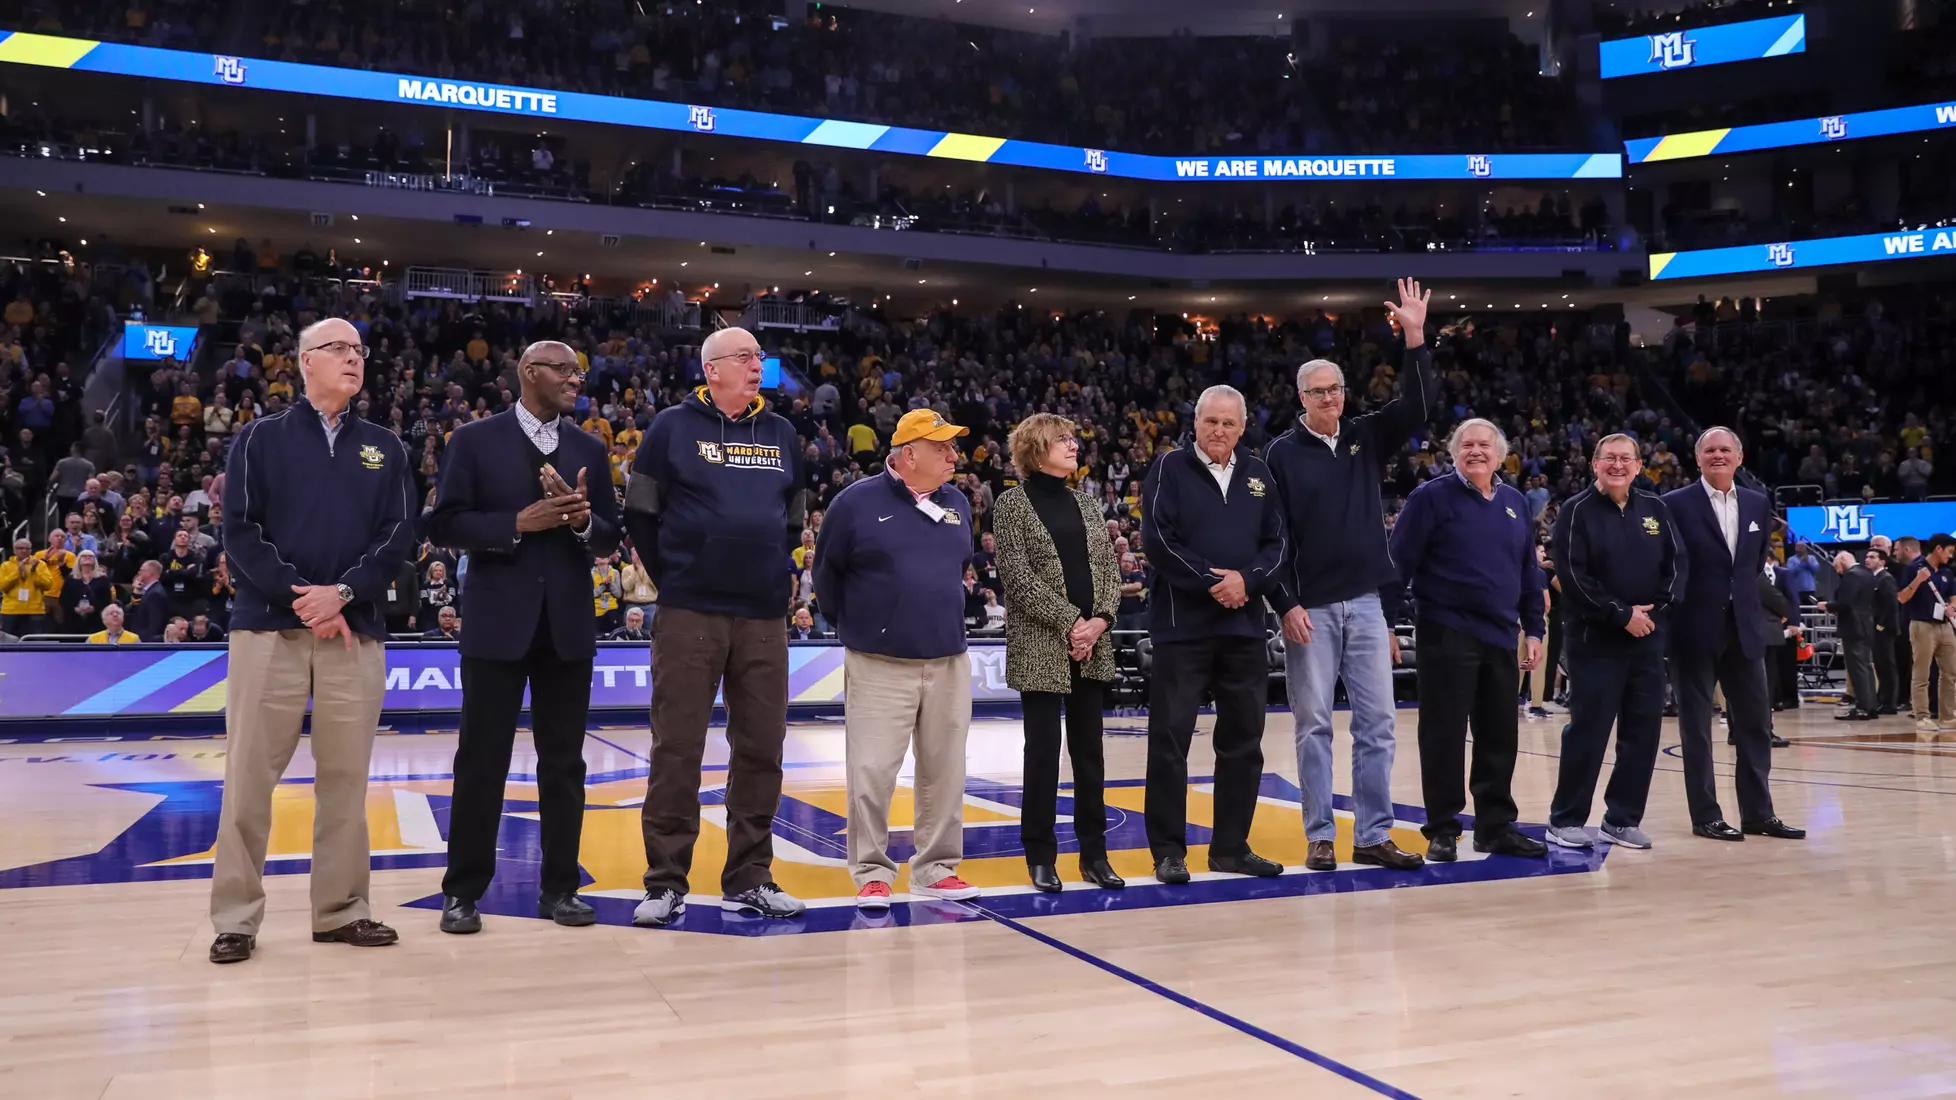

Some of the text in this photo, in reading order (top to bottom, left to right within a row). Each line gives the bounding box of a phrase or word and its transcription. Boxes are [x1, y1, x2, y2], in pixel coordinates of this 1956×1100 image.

[1647, 31, 1697, 71] MU
[213, 55, 248, 86] MU
[398, 79, 557, 113] MARQUETTE
[688, 104, 717, 133] MU
[1818, 115, 1848, 140] MU
[1084, 148, 1108, 172] MU
[1176, 159, 1395, 177] WE ARE MARQUETTE
[1466, 155, 1492, 177] MU
[604, 236, 618, 248] 117
[1883, 231, 1956, 255] WE A
[1765, 242, 1796, 268] MU
[143, 328, 178, 357] MU
[697, 440, 725, 464] MU
[728, 455, 783, 468] UNIVERSITY
[1820, 504, 1875, 543] MU
